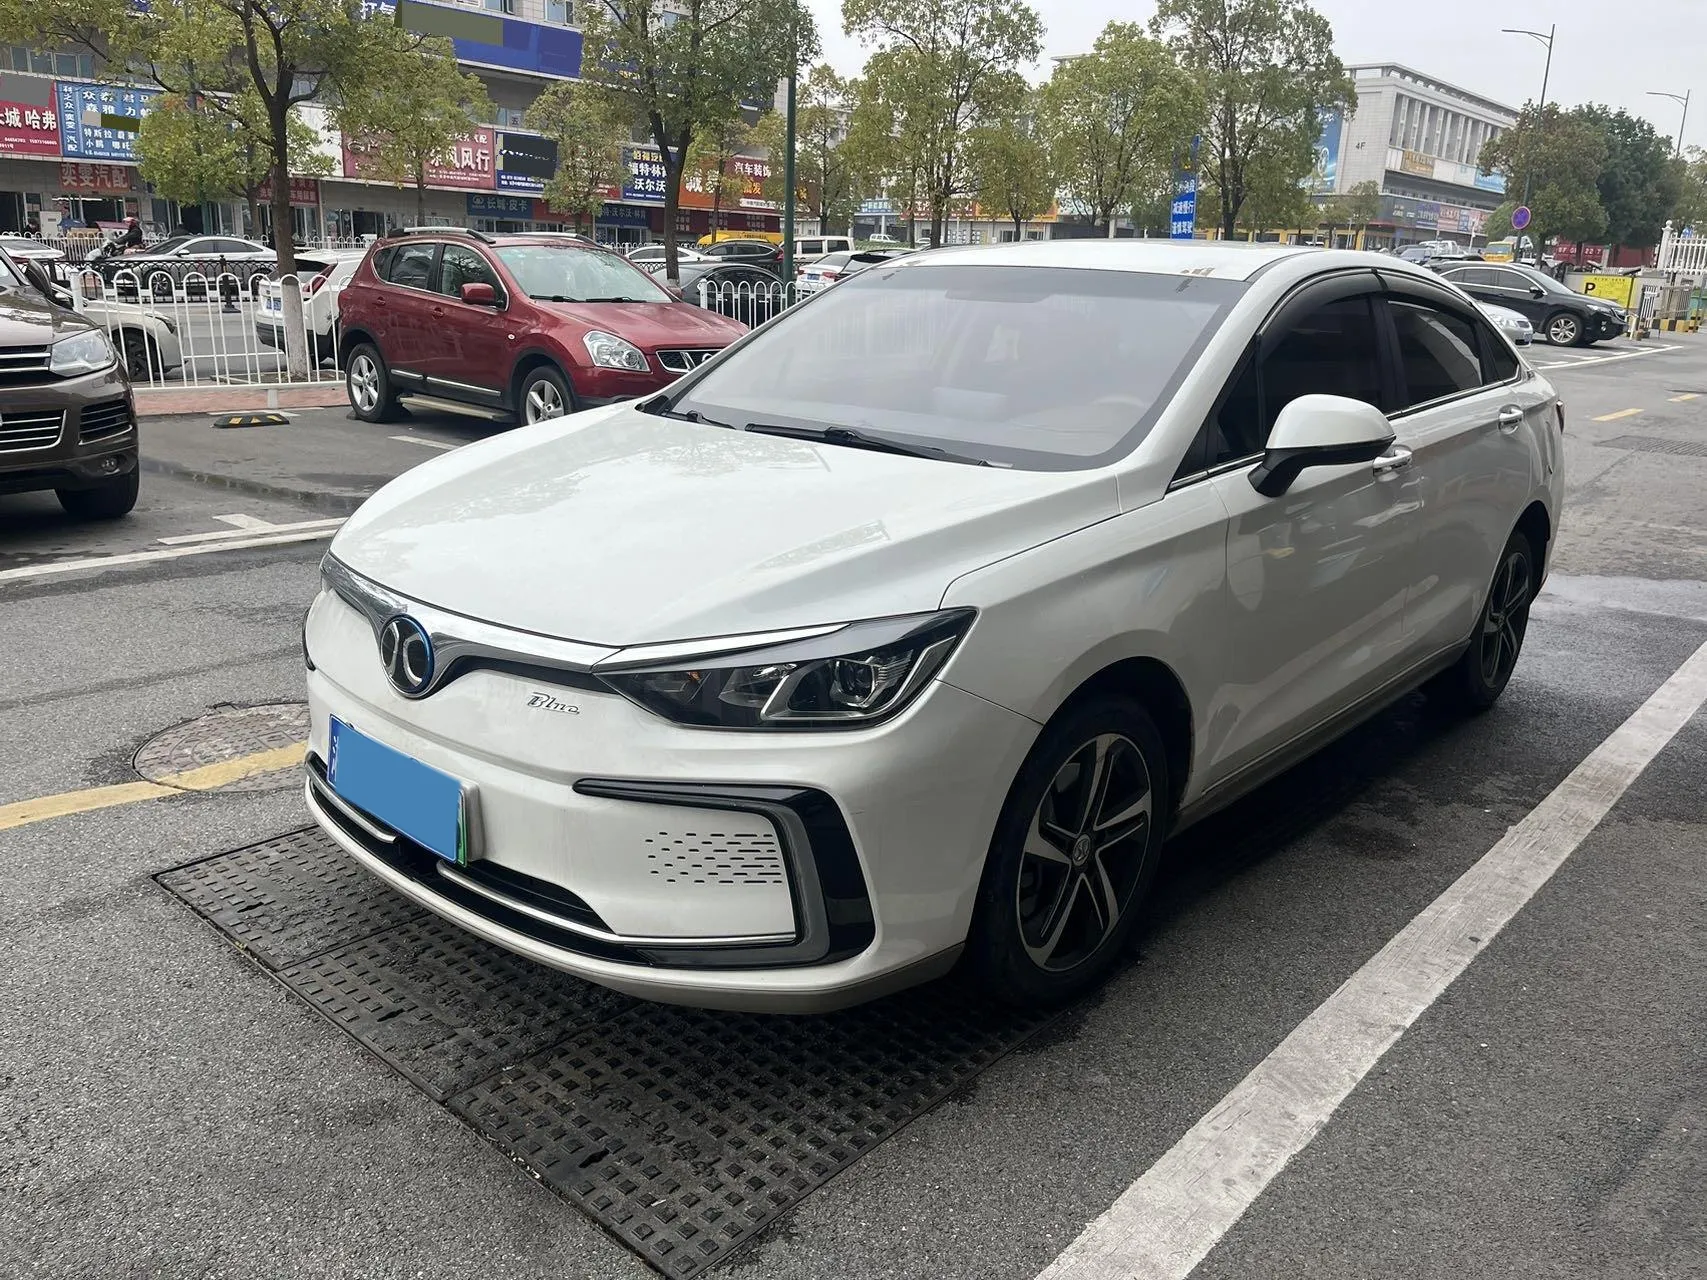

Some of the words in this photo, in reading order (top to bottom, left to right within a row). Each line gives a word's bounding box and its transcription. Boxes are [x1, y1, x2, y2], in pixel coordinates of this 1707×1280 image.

[25, 110, 57, 131] 哈弗
[83, 128, 113, 139] 特斯拉
[85, 139, 104, 149] 小鹏
[62, 164, 128, 188] 奕雯汽配
[734, 161, 772, 178] 汽车装饰
[633, 178, 666, 193] 沃尔沃
[1584, 282, 1596, 294] P
[527, 691, 580, 715] Blue
